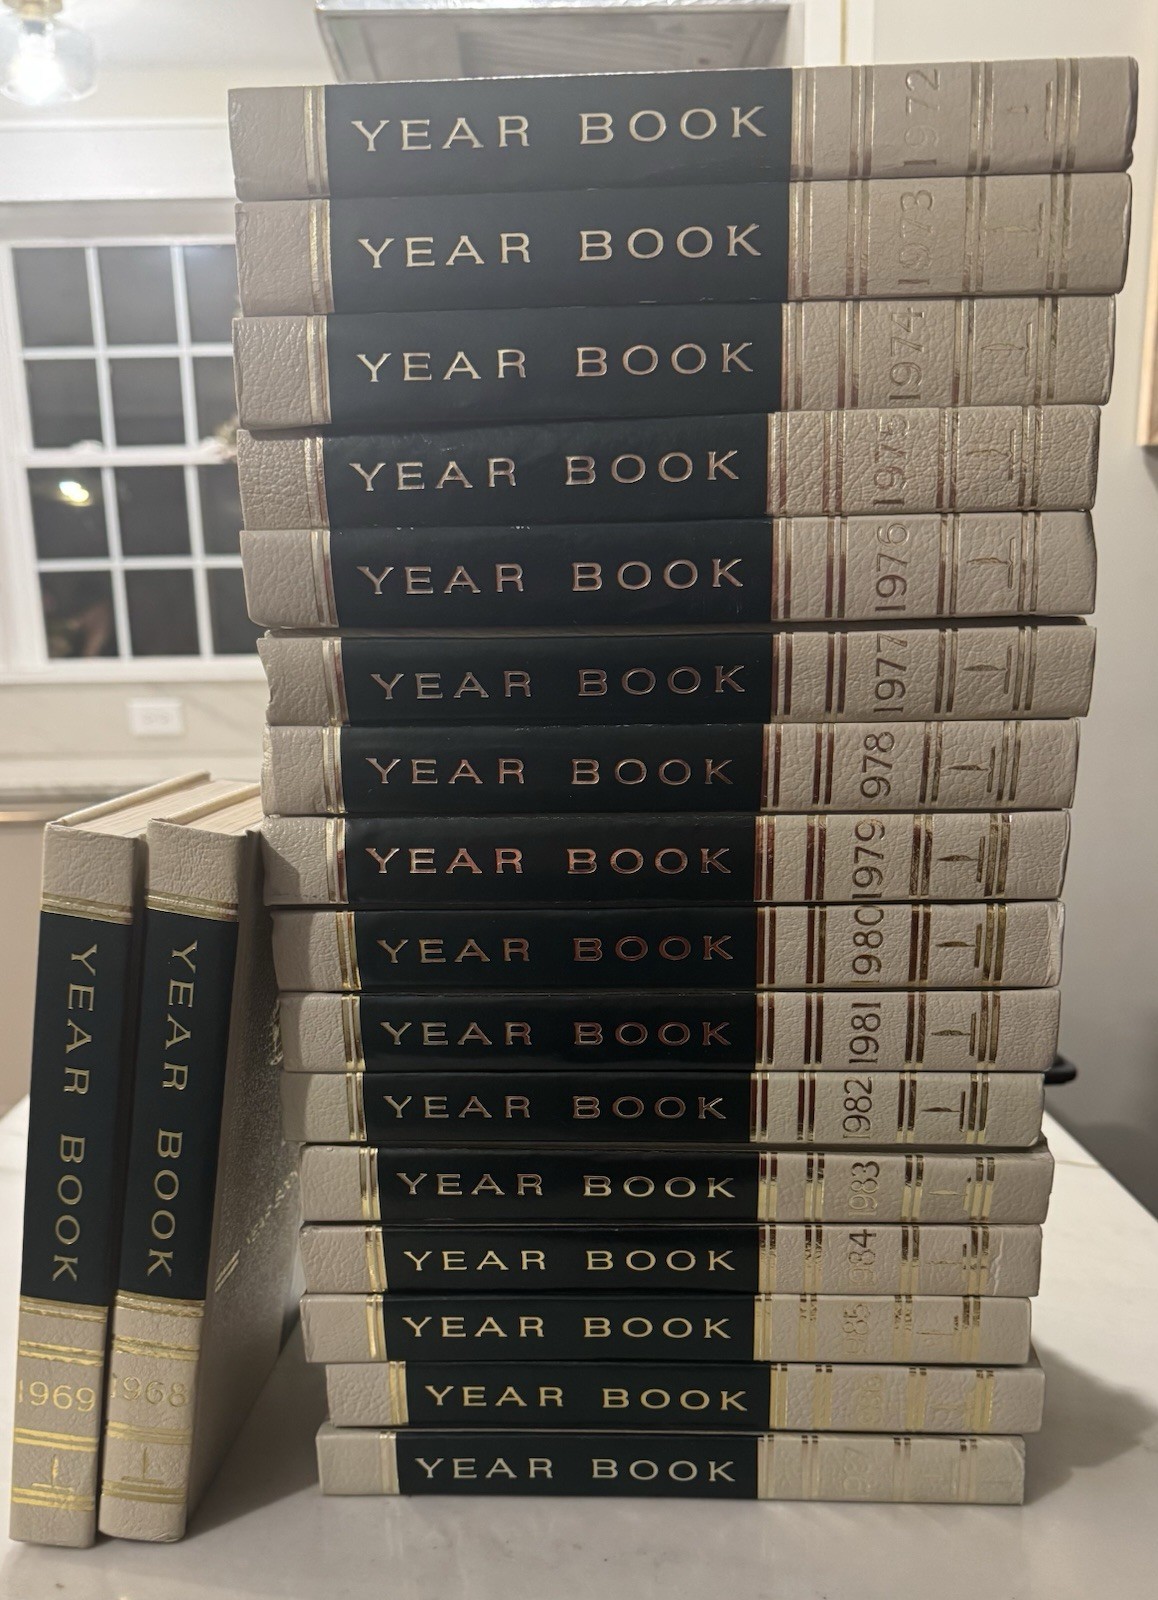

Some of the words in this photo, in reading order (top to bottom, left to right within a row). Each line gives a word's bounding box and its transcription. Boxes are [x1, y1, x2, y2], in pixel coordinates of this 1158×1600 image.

[351, 115, 530, 152] YEAR
[579, 106, 767, 145] BOOK
[903, 68, 940, 167] 1972
[358, 232, 531, 269] YEAR
[579, 223, 762, 262] BOOK
[898, 189, 934, 285] 1973
[357, 349, 527, 383] YEAR
[575, 342, 754, 377] BOOK
[889, 307, 925, 400] 1974
[349, 457, 517, 492] YEAR
[565, 450, 739, 486] BOOK
[873, 414, 910, 506] 1975
[357, 563, 524, 594] YEAR
[571, 558, 743, 592] BOOK
[874, 523, 910, 612] 1976
[371, 670, 532, 700] YEAR
[578, 665, 746, 697] BOOK
[873, 633, 907, 713] 1977
[365, 757, 525, 785] YEAR
[571, 757, 734, 785] BOOK
[859, 731, 896, 806] 978
[365, 847, 524, 874] YEAR
[566, 847, 731, 875] BOOK
[852, 818, 885, 900] 1979
[377, 937, 530, 964] YEAR
[573, 934, 734, 962] BOOK
[851, 904, 884, 984] 1980
[64, 943, 97, 1096] YEAR
[162, 940, 198, 1091] YEAR
[380, 1021, 533, 1046] YEAR
[573, 1021, 732, 1046] BOOK
[848, 1002, 881, 1064] 1981
[383, 1095, 531, 1119] YEAR
[572, 1095, 727, 1119] BOOK
[842, 1076, 872, 1139] 1982
[52, 1133, 86, 1282] BOOK
[147, 1128, 183, 1277] BOOK
[396, 1173, 543, 1196] YEAR
[583, 1175, 736, 1199] BOOK
[849, 1160, 880, 1216] 1983
[404, 1250, 546, 1271] YEAR
[586, 1250, 736, 1272] BOOK
[402, 1316, 545, 1338] YEAR
[583, 1316, 731, 1339] BOOK
[842, 1303, 871, 1356] 985
[17, 1379, 95, 1412] 1969
[109, 1373, 186, 1408] 1968
[425, 1385, 564, 1407] YEAR
[602, 1387, 748, 1412] BOOK
[415, 1457, 554, 1479] YEAR
[592, 1457, 736, 1482] BOOK
